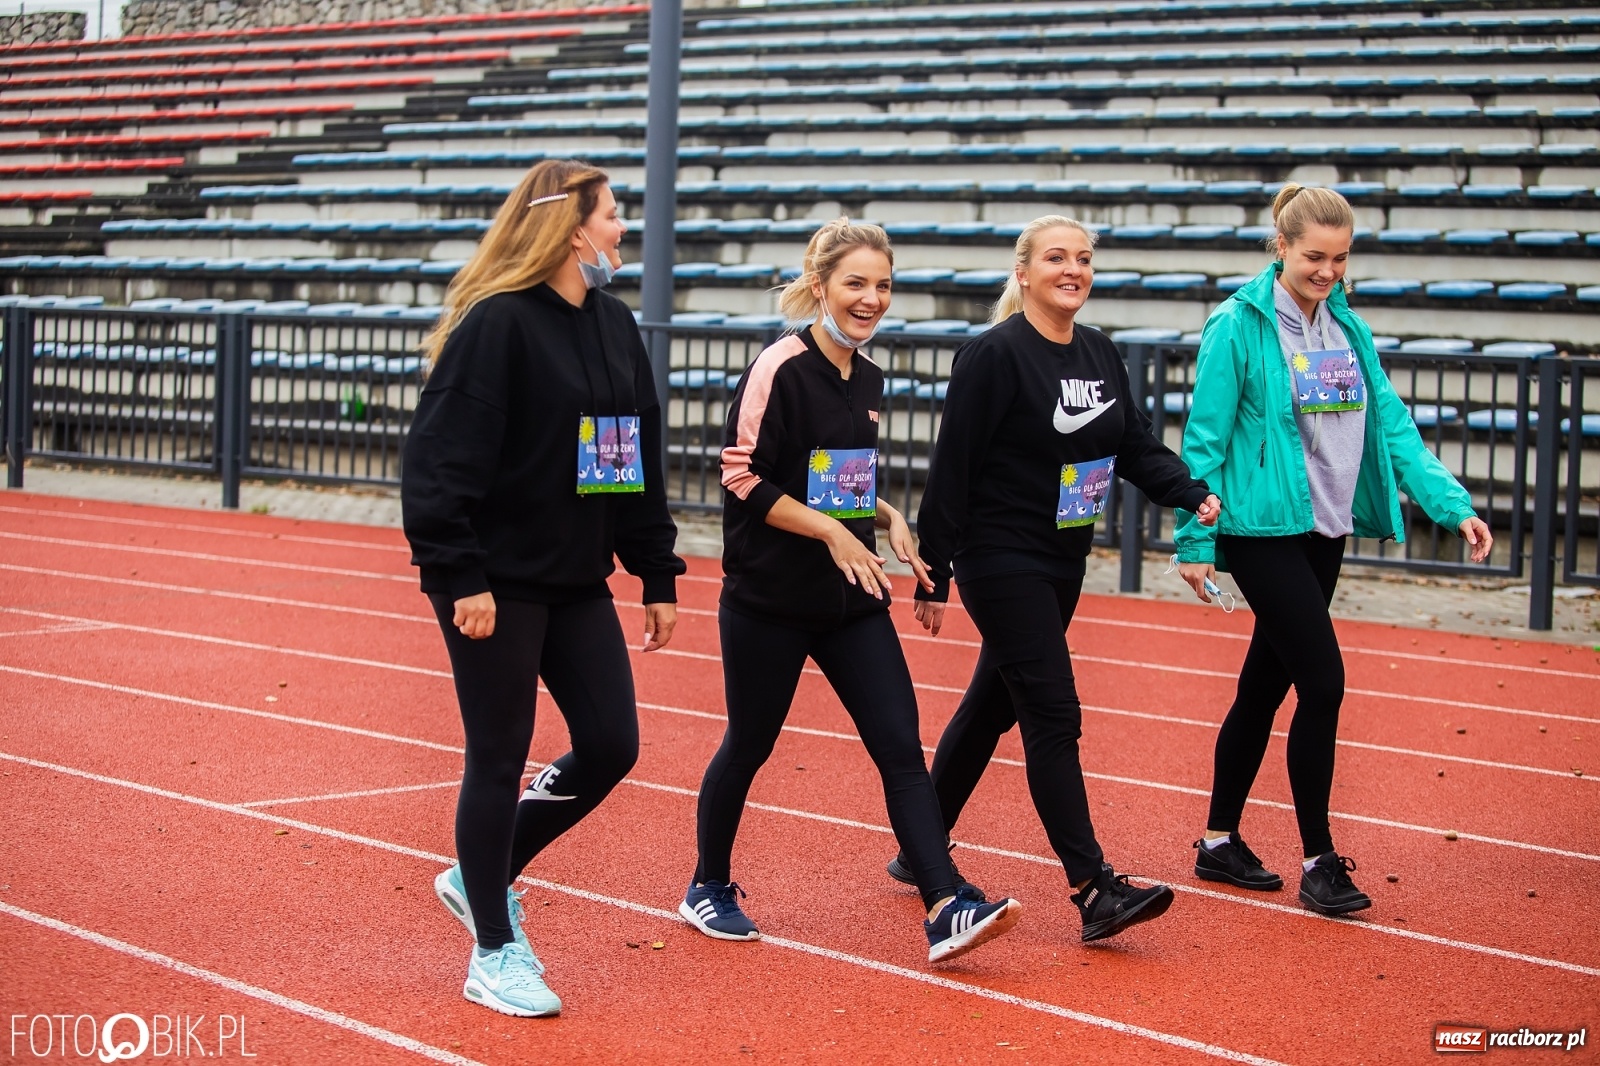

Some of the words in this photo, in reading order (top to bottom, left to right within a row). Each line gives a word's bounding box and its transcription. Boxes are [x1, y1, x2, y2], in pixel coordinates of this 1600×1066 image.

[1304, 372, 1318, 381] BIEG
[1320, 371, 1332, 379] DLA
[1060, 379, 1104, 408] NIKE
[1339, 389, 1358, 401] 030
[600, 444, 611, 454] DLA
[613, 467, 637, 482] 300
[820, 474, 836, 482] BIEG
[839, 473, 851, 482] DLA
[1069, 485, 1081, 495] BIEG
[1083, 484, 1093, 493] DLA
[854, 495, 871, 508] 302
